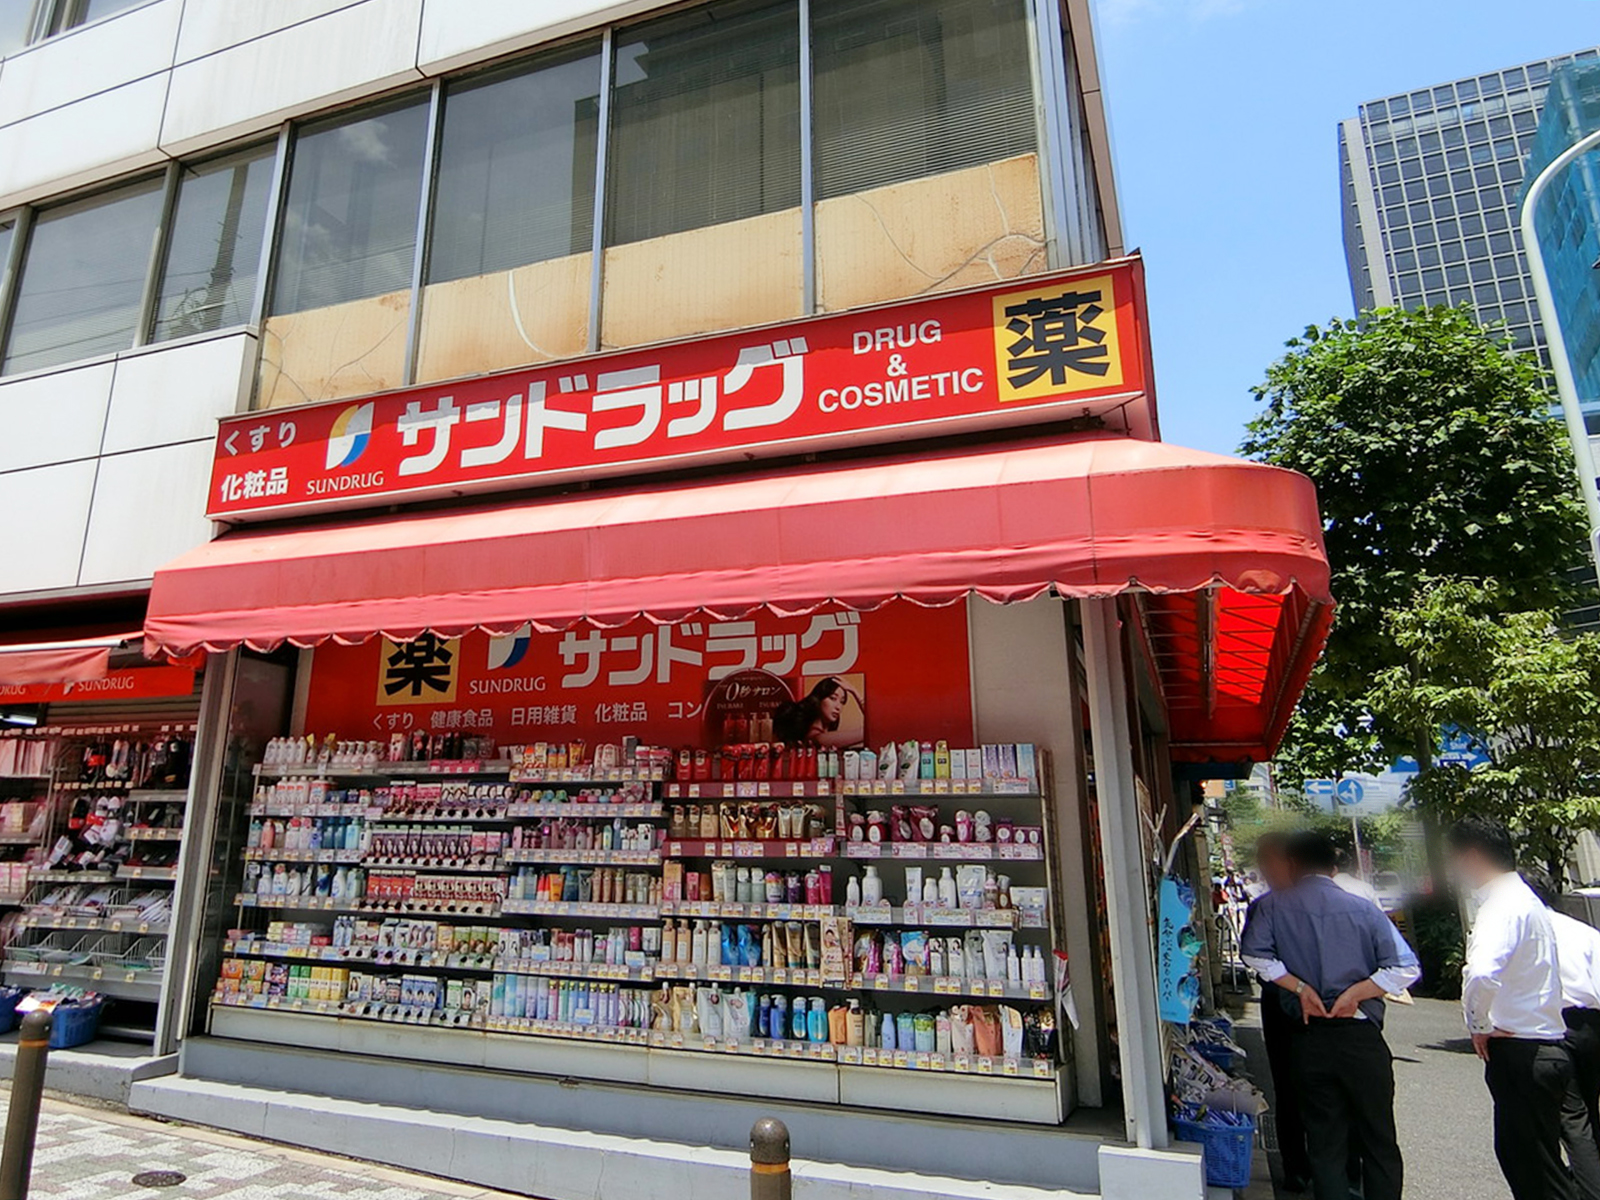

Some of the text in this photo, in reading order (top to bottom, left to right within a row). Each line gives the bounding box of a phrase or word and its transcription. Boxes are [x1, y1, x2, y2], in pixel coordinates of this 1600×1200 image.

[853, 319, 942, 355] DRUG
[1005, 290, 1111, 389] 薬
[887, 354, 908, 377] &
[397, 337, 809, 476] サンドラッグ
[818, 367, 984, 413] COSMETIC
[223, 421, 297, 456] くすり
[220, 467, 289, 502] 化粧品
[306, 471, 384, 496] SUNDRUG
[558, 611, 861, 688] サンドラッグ
[78, 676, 134, 692] SUNDRUG
[469, 676, 546, 695] SUNDRUG
[372, 712, 414, 730] くすり
[430, 708, 493, 729] 健康食品
[510, 705, 577, 726] 日用雑貨
[594, 702, 648, 723] 化粧品
